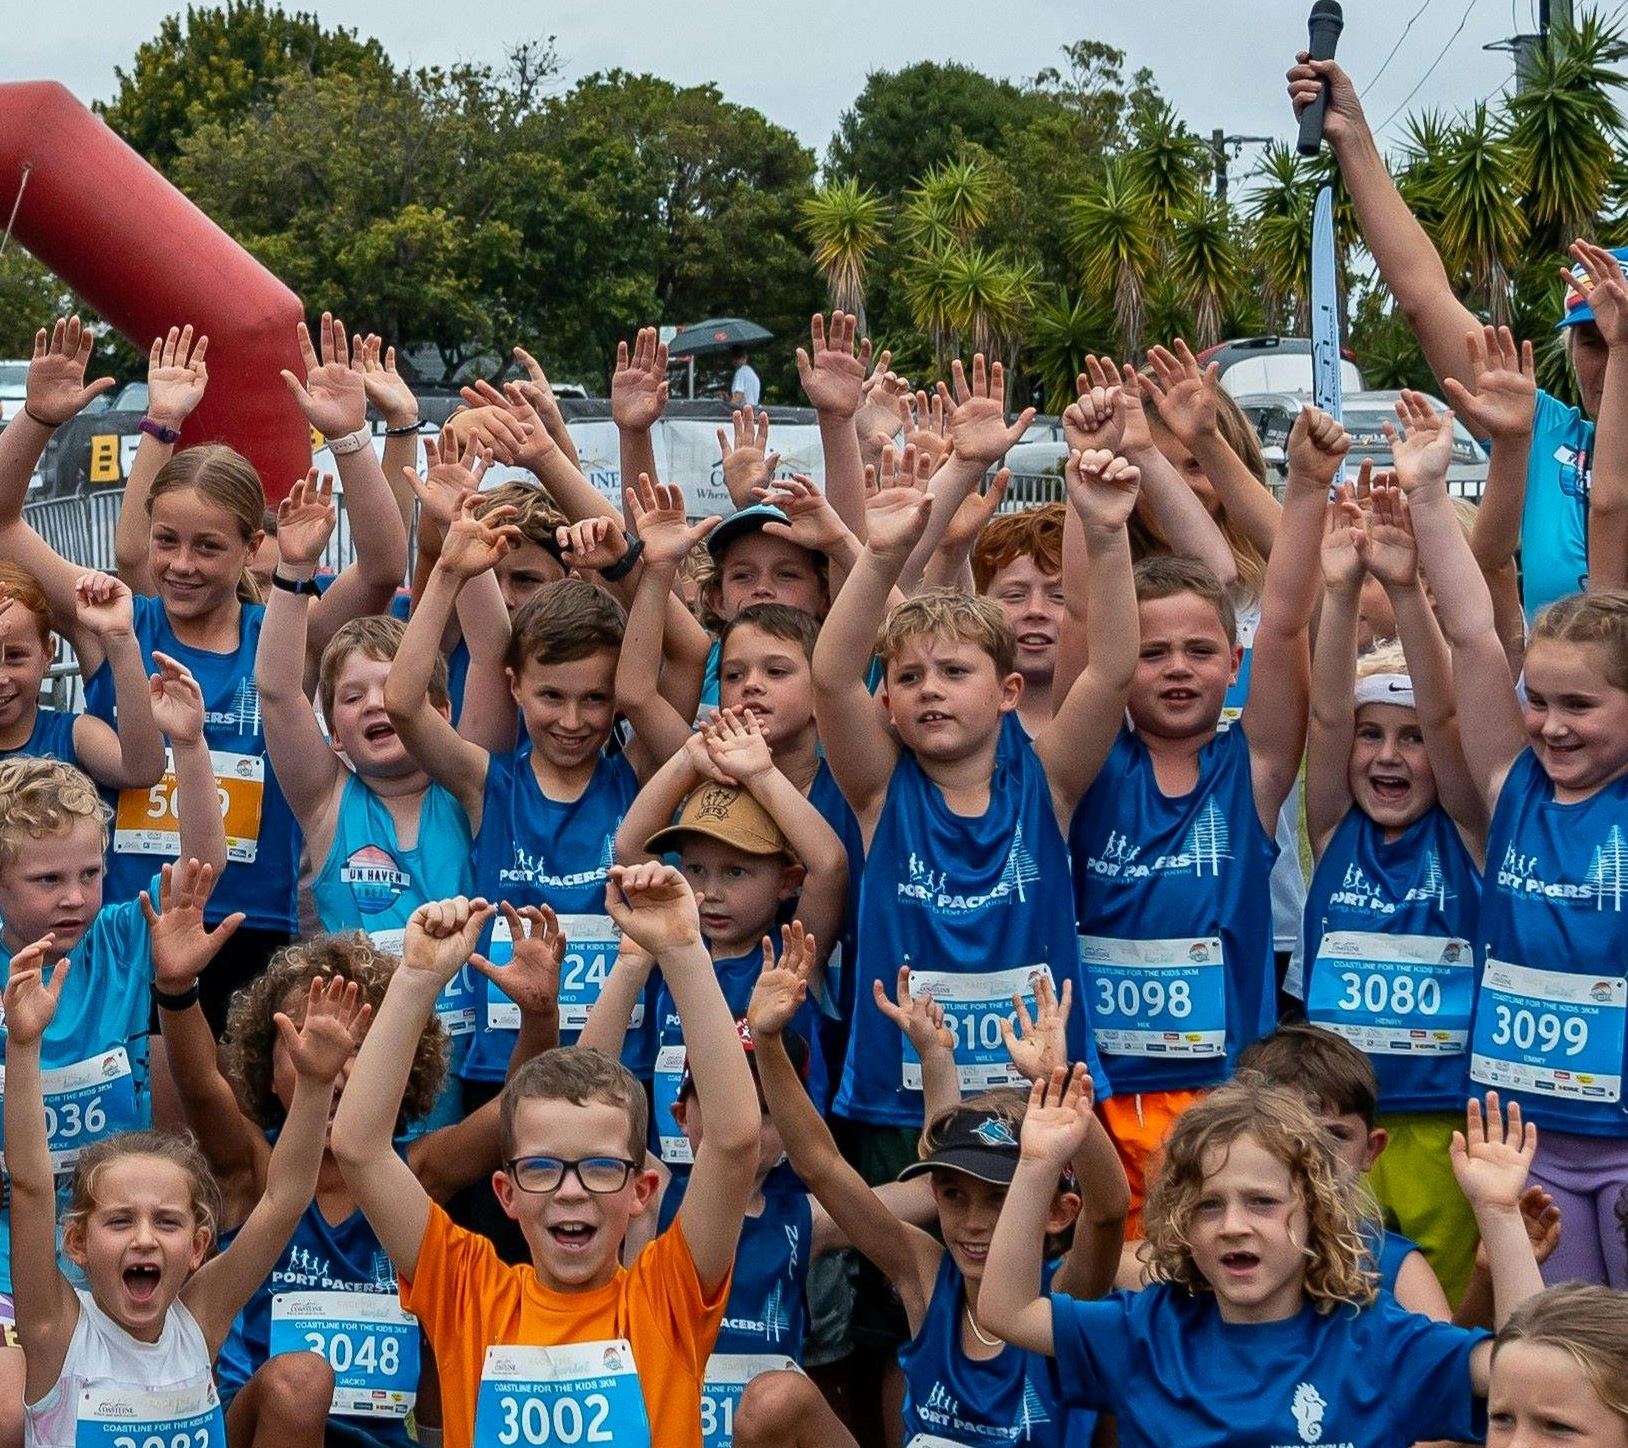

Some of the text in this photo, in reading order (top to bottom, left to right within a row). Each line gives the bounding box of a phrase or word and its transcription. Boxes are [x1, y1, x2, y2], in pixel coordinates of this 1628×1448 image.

[349, 868, 402, 884] UN HAVEN
[500, 867, 608, 888] PORT PACERS
[1096, 978, 1192, 1018] 3098
[1338, 972, 1441, 1015] 3080
[1492, 1006, 1588, 1056] 3099
[273, 1271, 388, 1294] PORT PACERS
[295, 1321, 340, 1329] COASTLINE
[342, 1322, 357, 1330] FOR
[721, 1318, 766, 1332] ACERS
[495, 1379, 617, 1393] COASTLINE FOR THE KIDS 3KM
[103, 1421, 188, 1433] COASTLINE FOR THE
[498, 1394, 613, 1445] 3002
